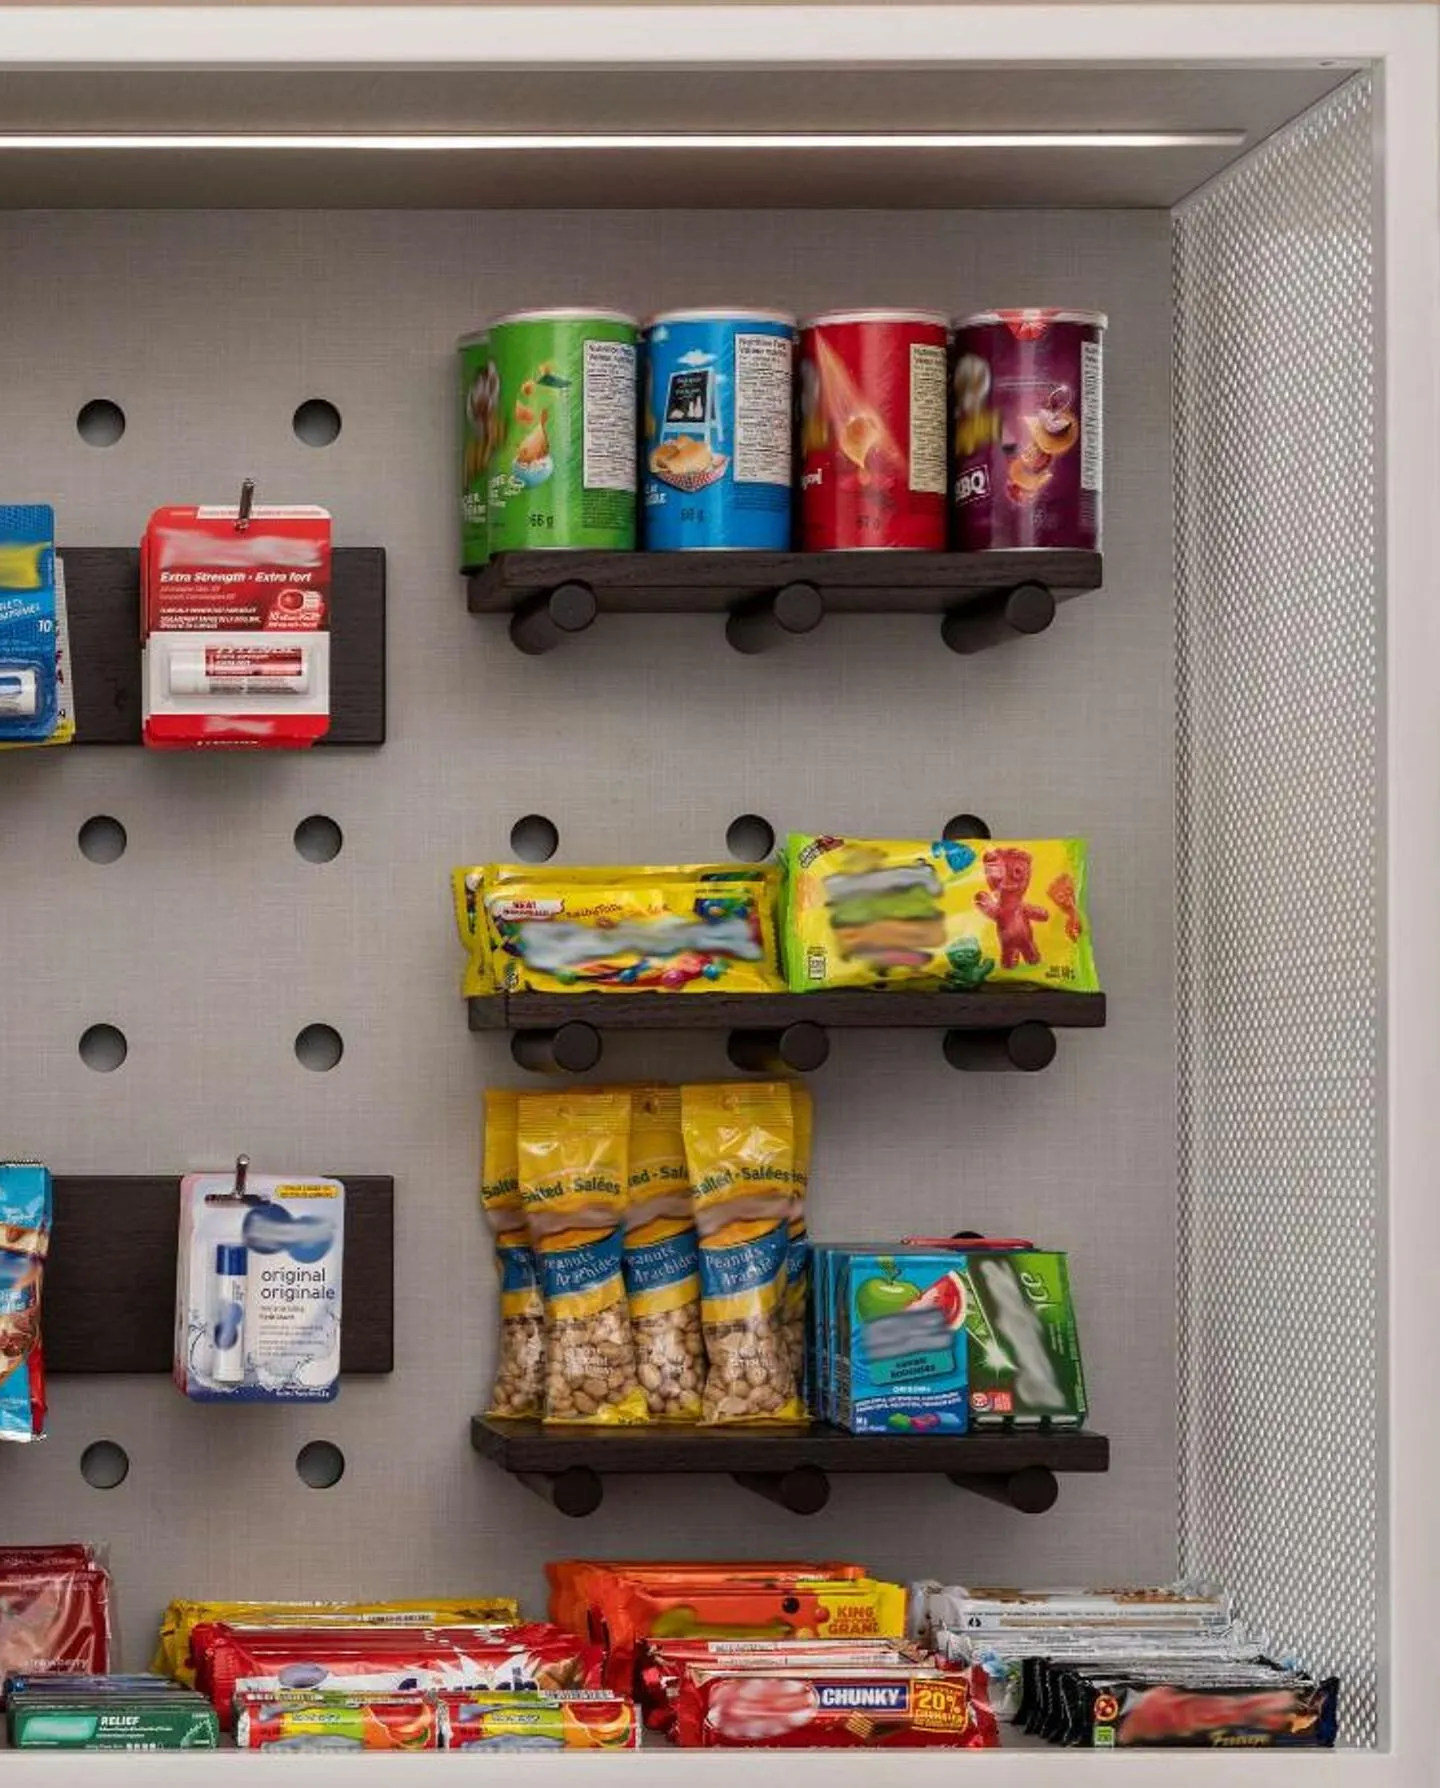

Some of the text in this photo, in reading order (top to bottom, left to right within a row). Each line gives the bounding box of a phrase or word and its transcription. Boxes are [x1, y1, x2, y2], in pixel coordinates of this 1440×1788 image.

[160, 572, 191, 582] Extra
[194, 572, 245, 584] Strength
[255, 572, 287, 583] Extra
[38, 619, 53, 633] 10
[261, 1267, 326, 1286] original
[260, 1284, 336, 1303] originale
[837, 1606, 874, 1618] KING
[822, 1687, 900, 1707] CHUNKY
[918, 1689, 962, 1714] 20%
[100, 1716, 141, 1727] RELIEF
